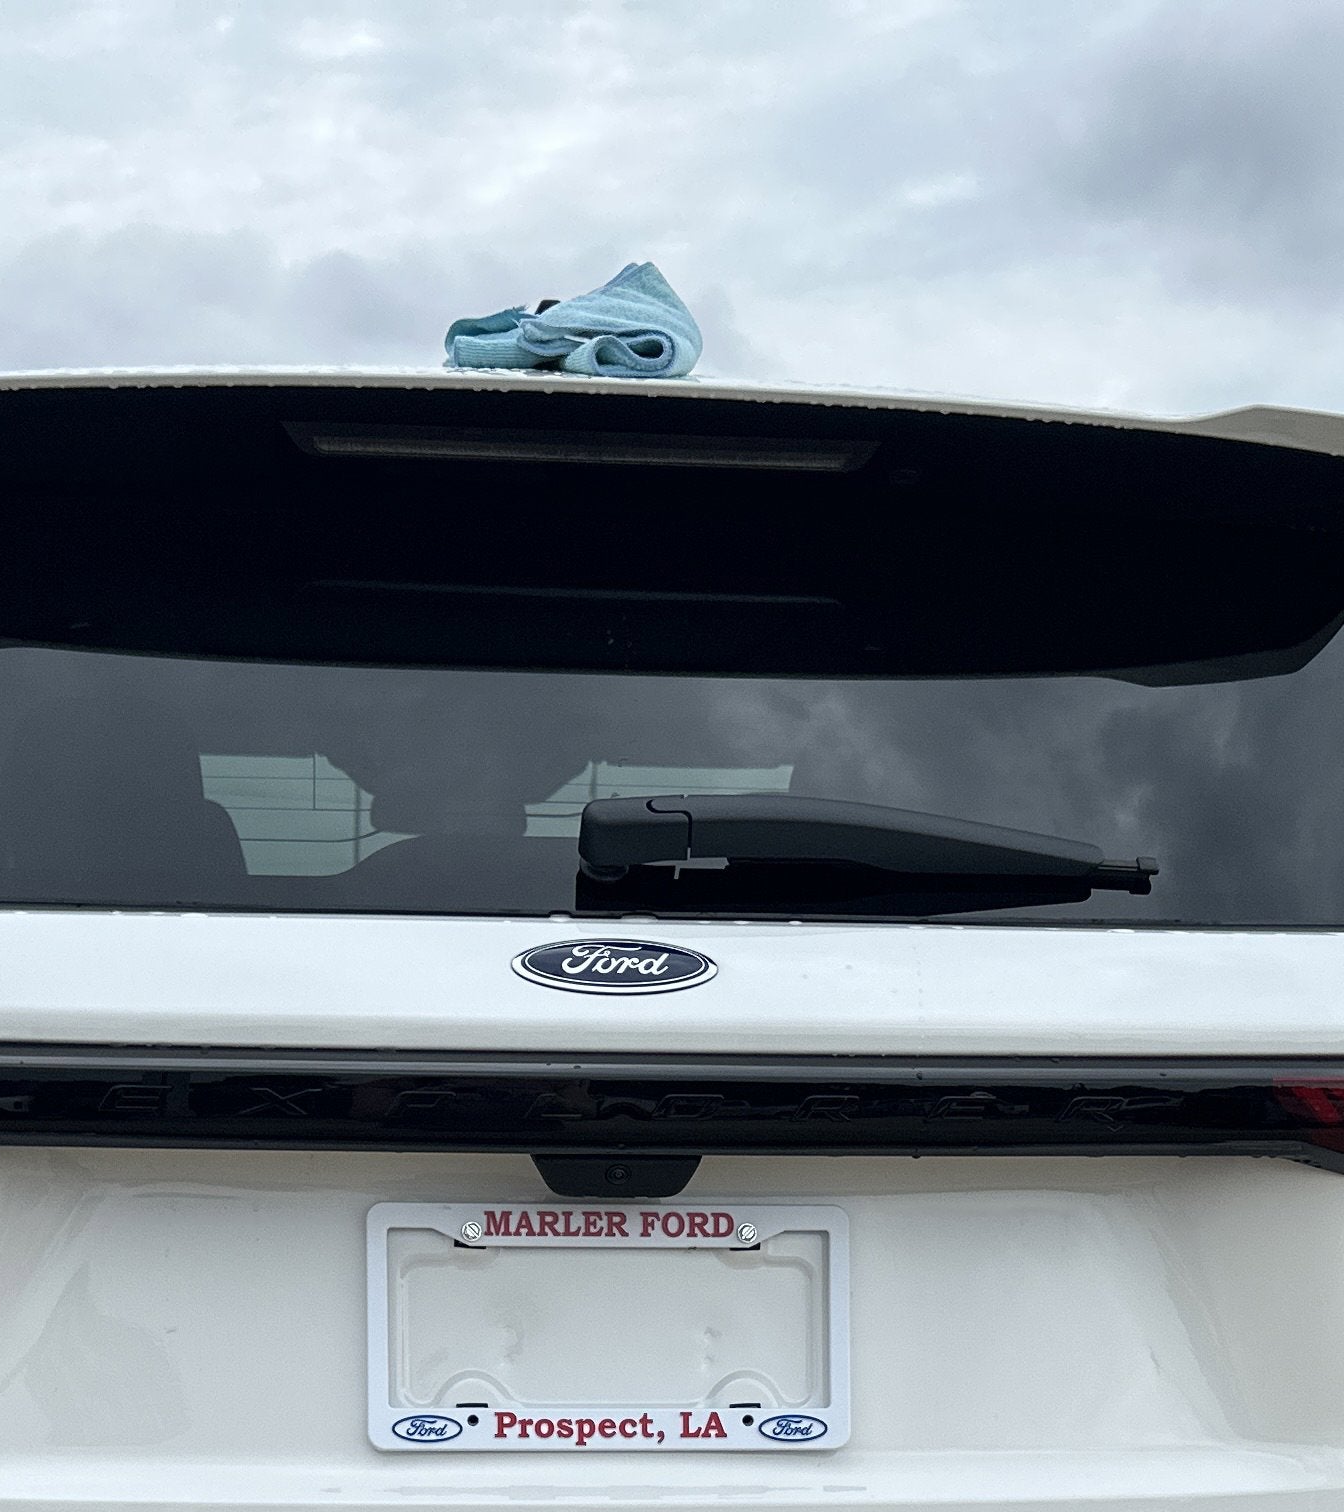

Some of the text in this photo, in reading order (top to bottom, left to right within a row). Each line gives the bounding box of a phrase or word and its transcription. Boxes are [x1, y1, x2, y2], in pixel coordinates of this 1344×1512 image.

[561, 944, 670, 976] Ford
[483, 1210, 736, 1239] MARLER FORD
[494, 1412, 728, 1445] Prospect, LA
